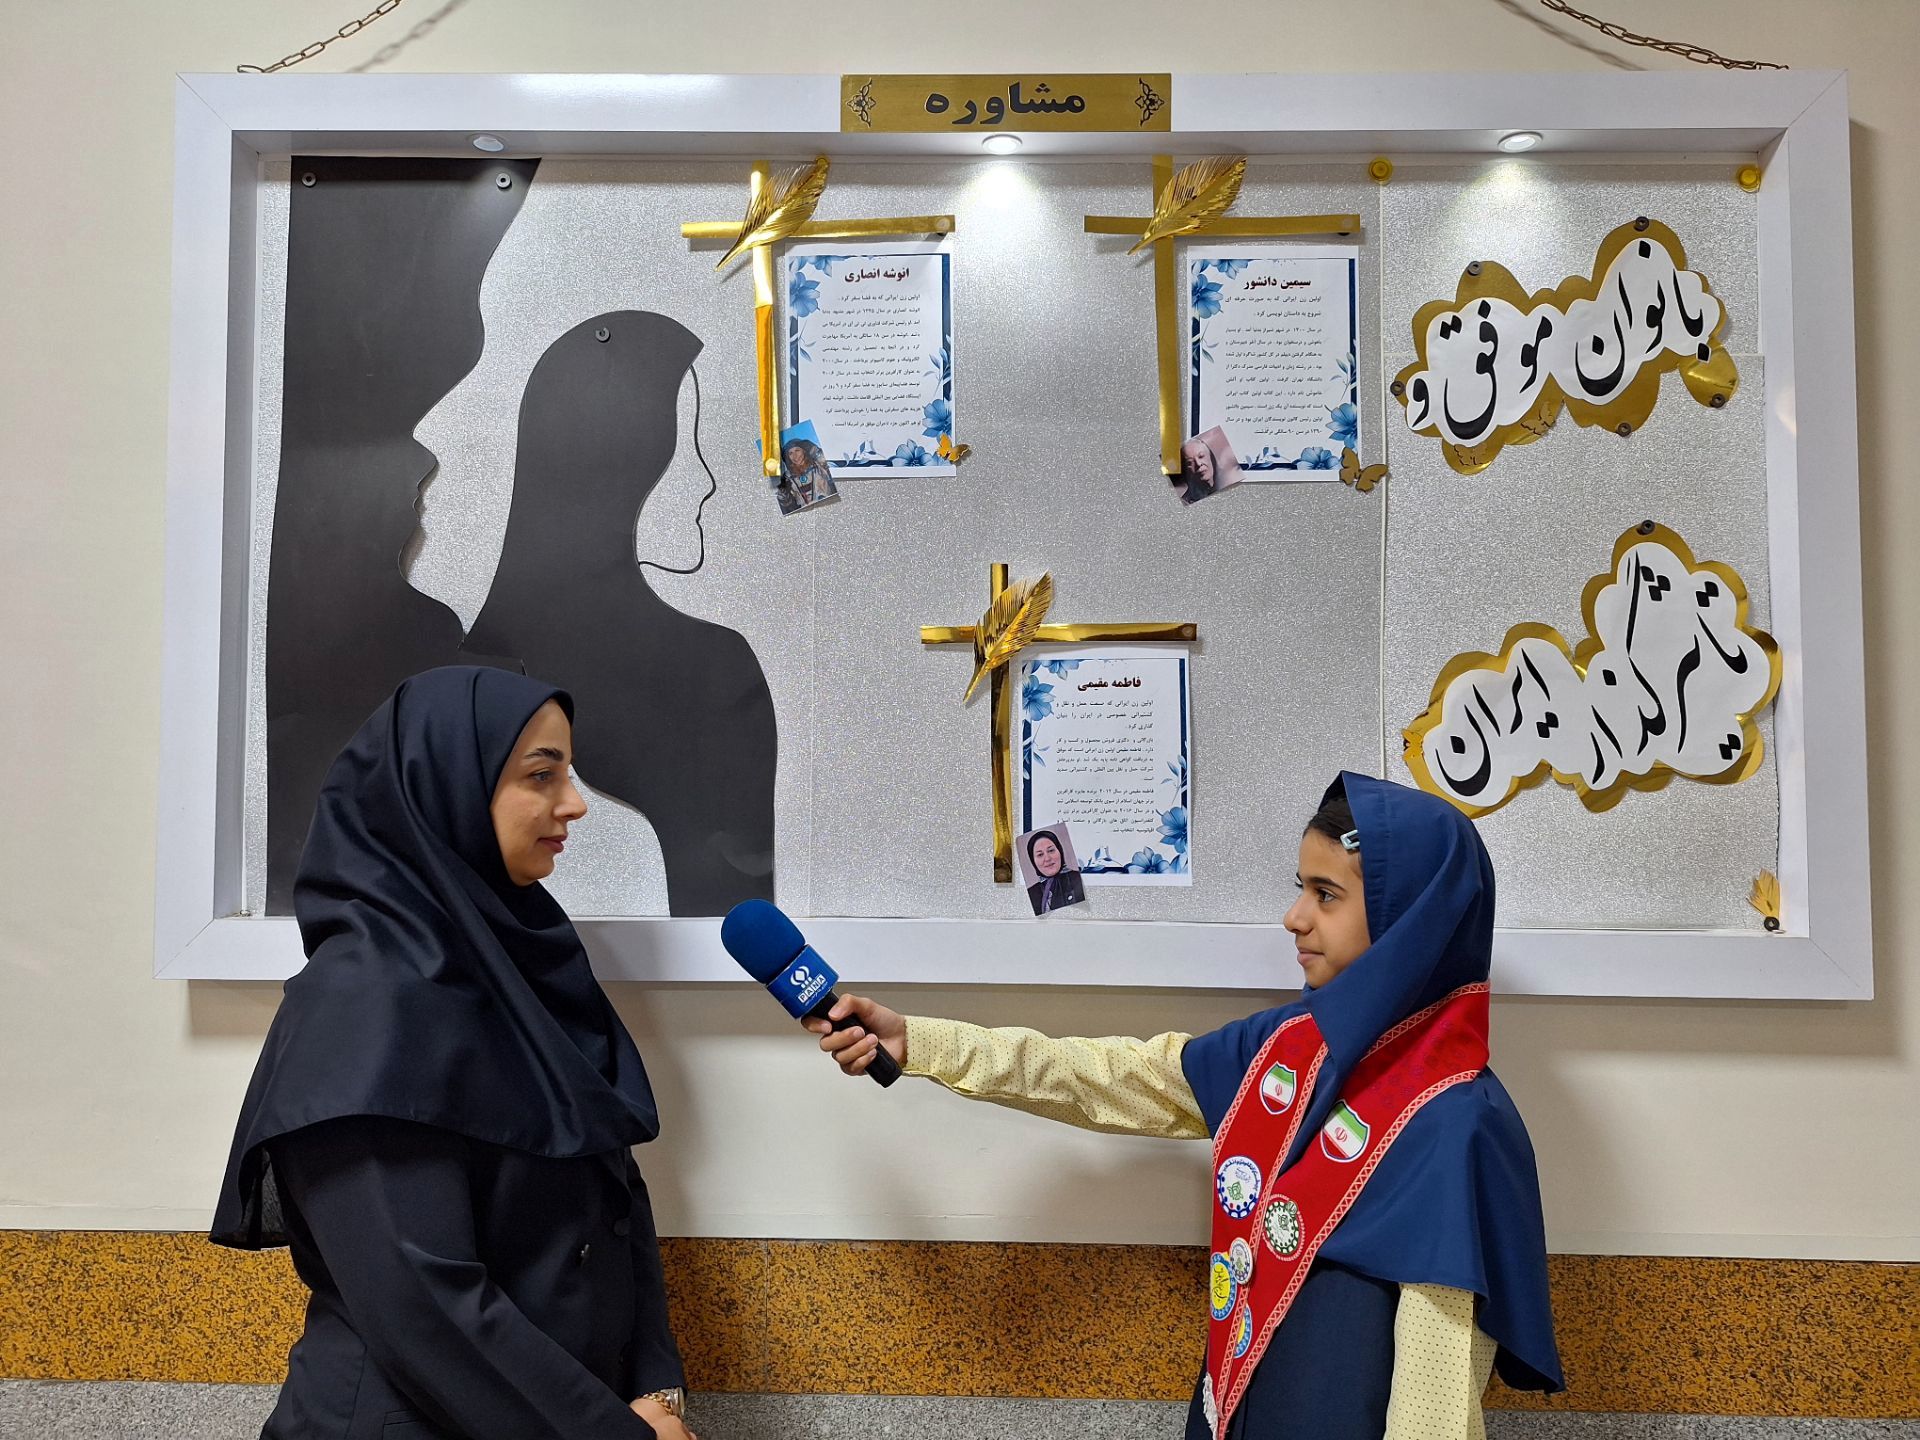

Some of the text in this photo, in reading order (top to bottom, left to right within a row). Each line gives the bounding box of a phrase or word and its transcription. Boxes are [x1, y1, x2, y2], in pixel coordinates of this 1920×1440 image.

[925, 81, 1085, 125] مشاوره
[845, 268, 909, 282] انوشه انصاری
[1244, 276, 1311, 289] سیمین دانشور
[1411, 239, 1712, 441] بانوان موفق و
[1078, 676, 1141, 691] فاطمه مقیمی
[1435, 648, 1559, 797] ایران
[798, 974, 826, 1003] PANA
